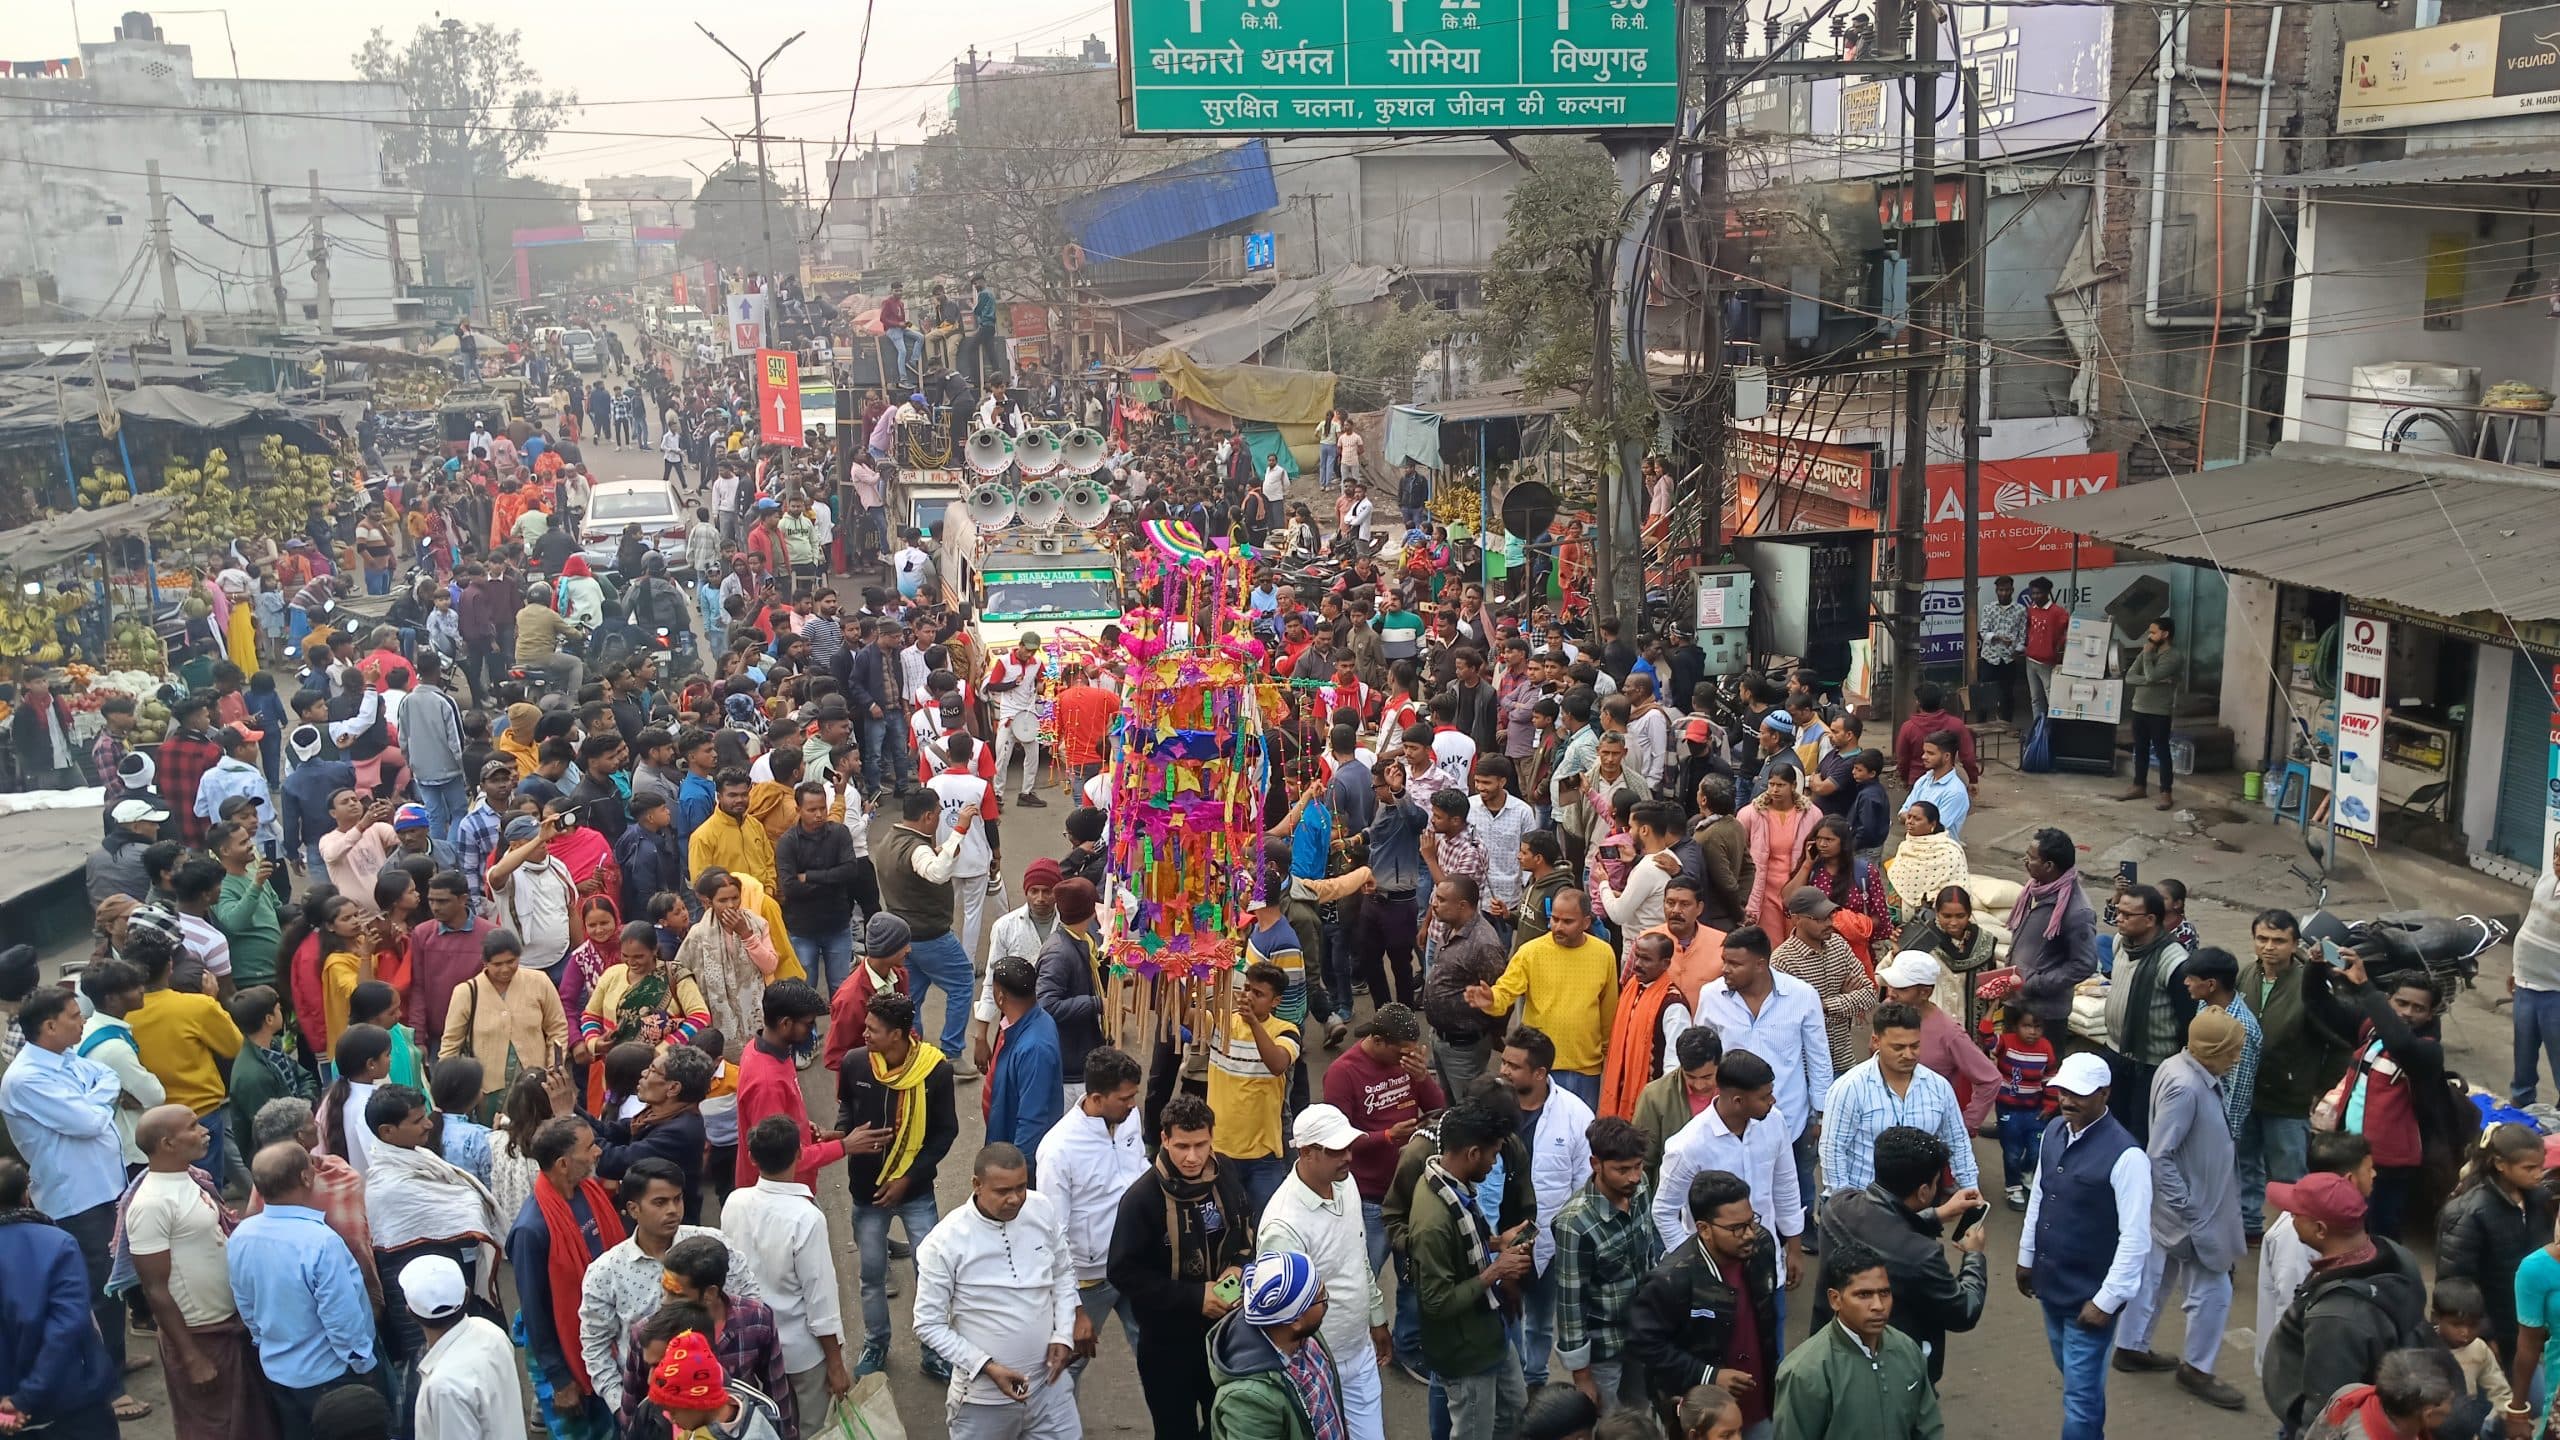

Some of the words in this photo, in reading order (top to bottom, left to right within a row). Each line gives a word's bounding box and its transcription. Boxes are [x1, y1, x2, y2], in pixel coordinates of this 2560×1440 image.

[1241, 12, 1282, 30] कि.मी.
[1442, 13, 1480, 30] कि.मी.
[1612, 13, 1648, 30] कि.मी.
[1149, 38, 1244, 75] बोकारो
[1261, 40, 1334, 75] थर्मल
[1387, 39, 1481, 74] गोमिया
[1551, 39, 1648, 82] विष्णुगढ़
[2507, 52, 2556, 70] V-GUARD
[1201, 93, 1279, 126] सुरक्षित
[1291, 99, 1363, 120] चलना,
[1374, 99, 1435, 124] कुशल
[1446, 90, 1505, 116] जीवन
[1517, 90, 1544, 115] की
[1556, 96, 1626, 115] कल्पना
[2520, 97, 2534, 108] S.N.
[767, 357, 786, 370] CITI
[2449, 626, 2490, 641] BOKARO
[2346, 643, 2382, 656] POLYWIN
[2341, 715, 2370, 730] KWW
[1440, 755, 1467, 770] ALIYA
